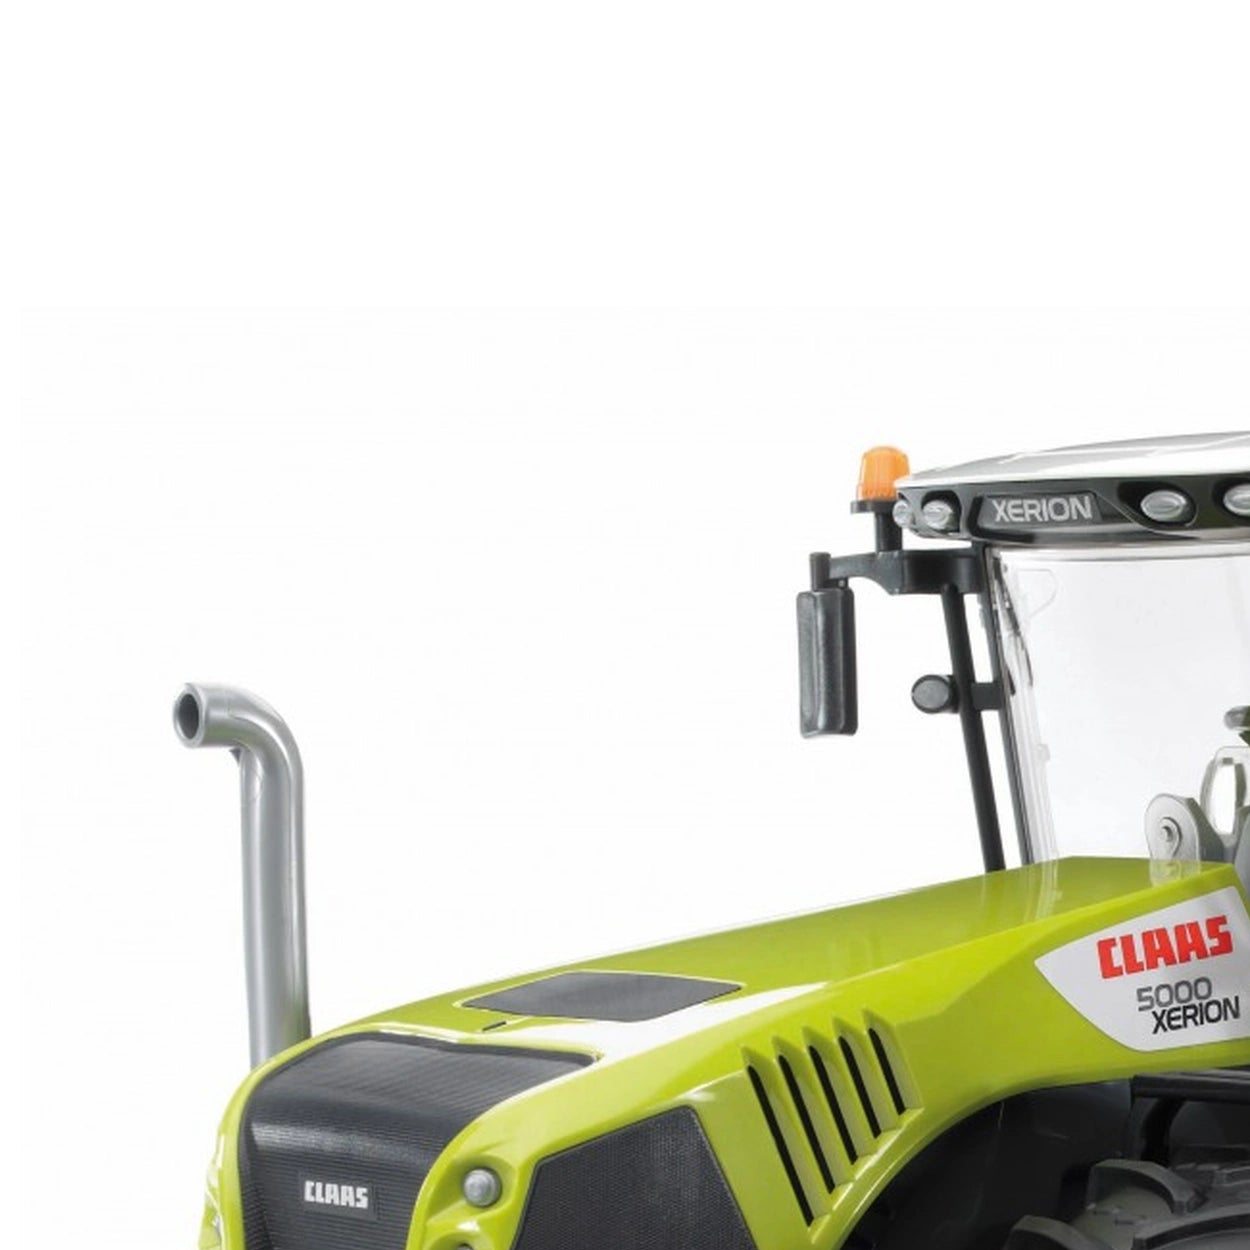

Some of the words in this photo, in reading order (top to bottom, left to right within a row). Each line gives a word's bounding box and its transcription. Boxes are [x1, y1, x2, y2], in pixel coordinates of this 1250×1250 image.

[992, 496, 1093, 522] XERION
[1097, 915, 1233, 979] CLAAS
[1136, 977, 1212, 1011] 5000
[1152, 996, 1240, 1034] XERION
[304, 1180, 368, 1209] CLAAS
